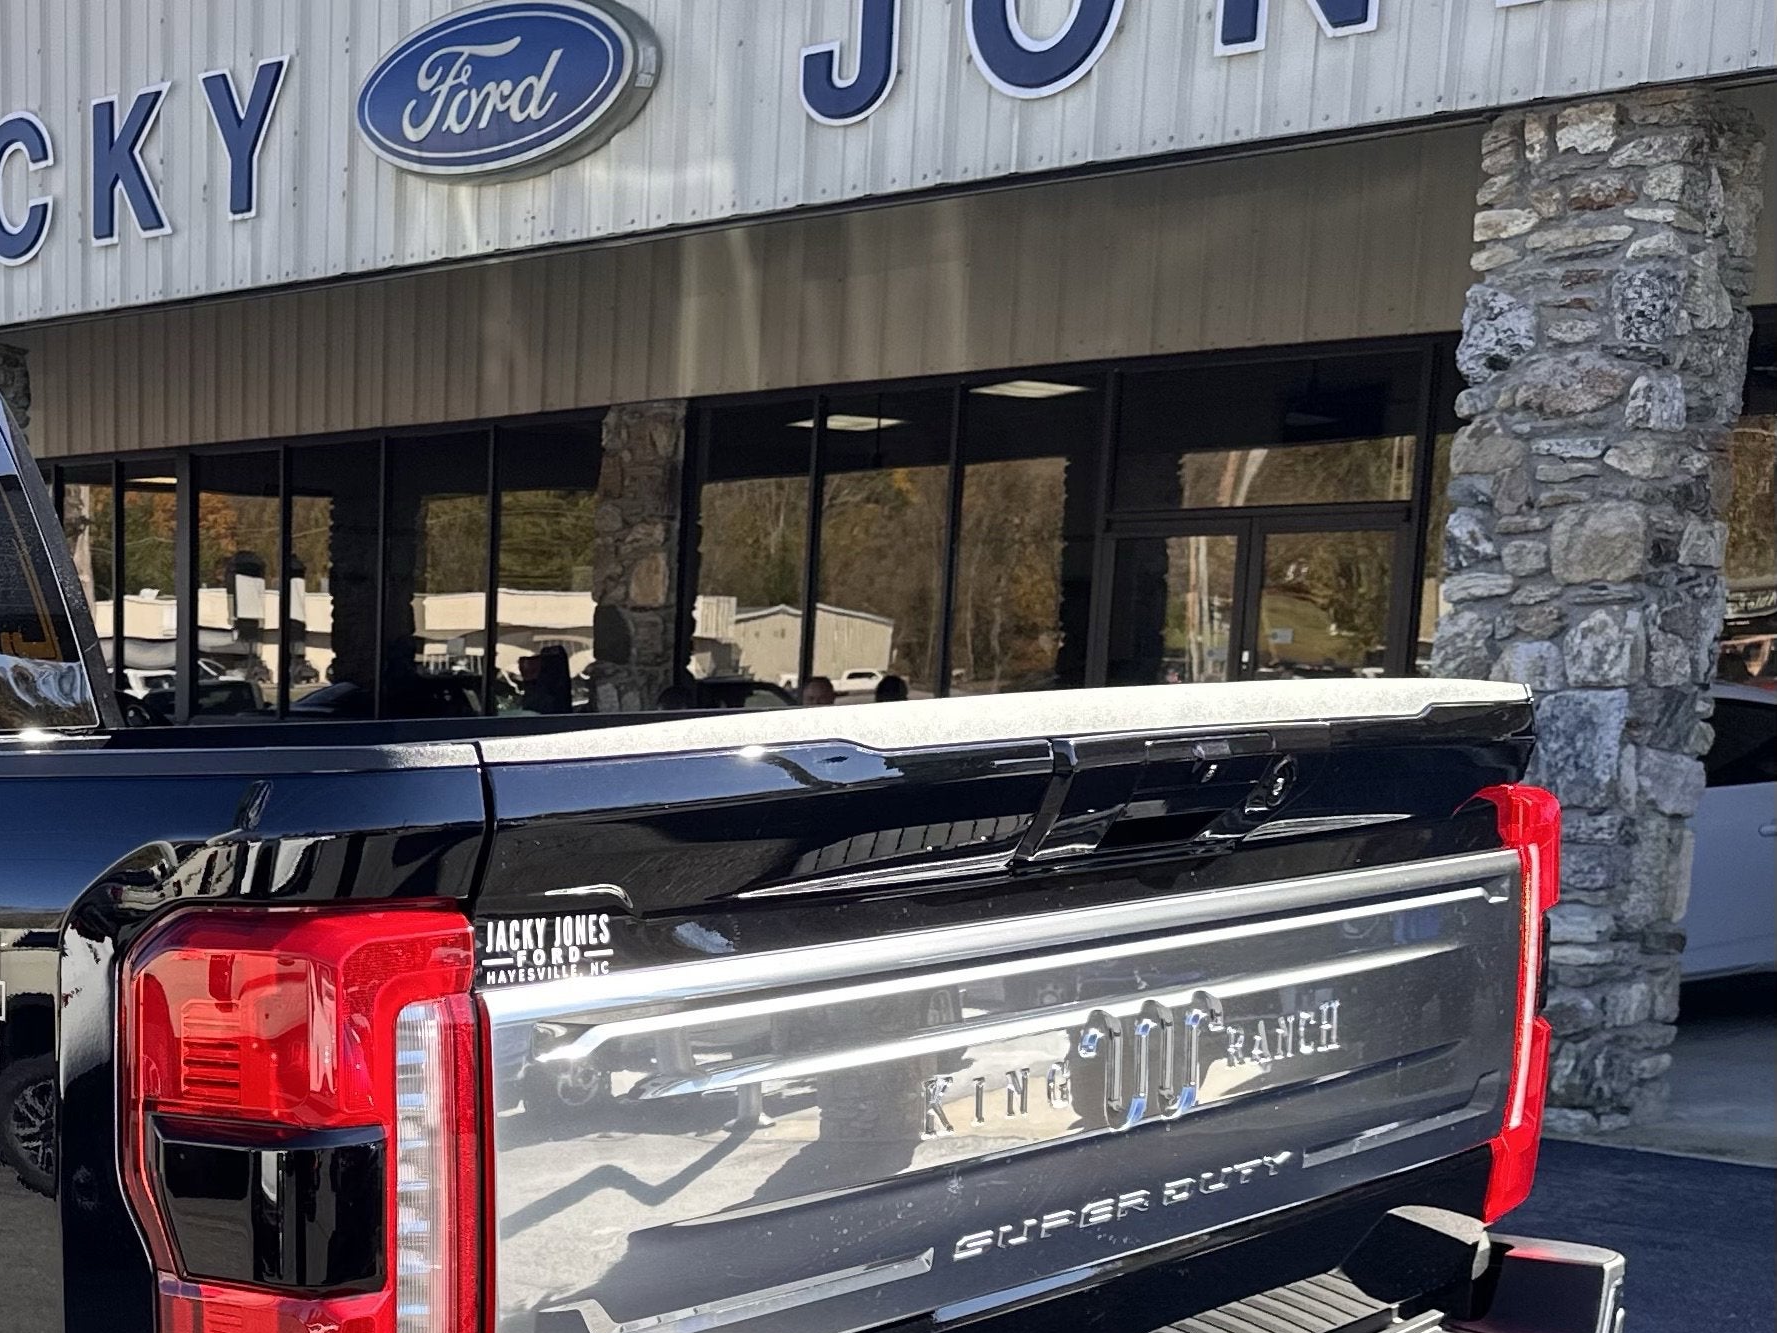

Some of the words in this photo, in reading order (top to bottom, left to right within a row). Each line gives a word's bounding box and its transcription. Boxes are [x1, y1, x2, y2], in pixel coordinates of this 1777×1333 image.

[401, 35, 564, 145] Ford
[485, 917, 547, 954] JACKY
[553, 913, 611, 948] JONES
[516, 945, 581, 968] FORD
[590, 960, 610, 976] NC
[920, 1061, 1072, 1141] KING
[1226, 1000, 1341, 1068] RANCH
[953, 1188, 1151, 1262] SUPER
[1163, 1150, 1293, 1206] DUTY
